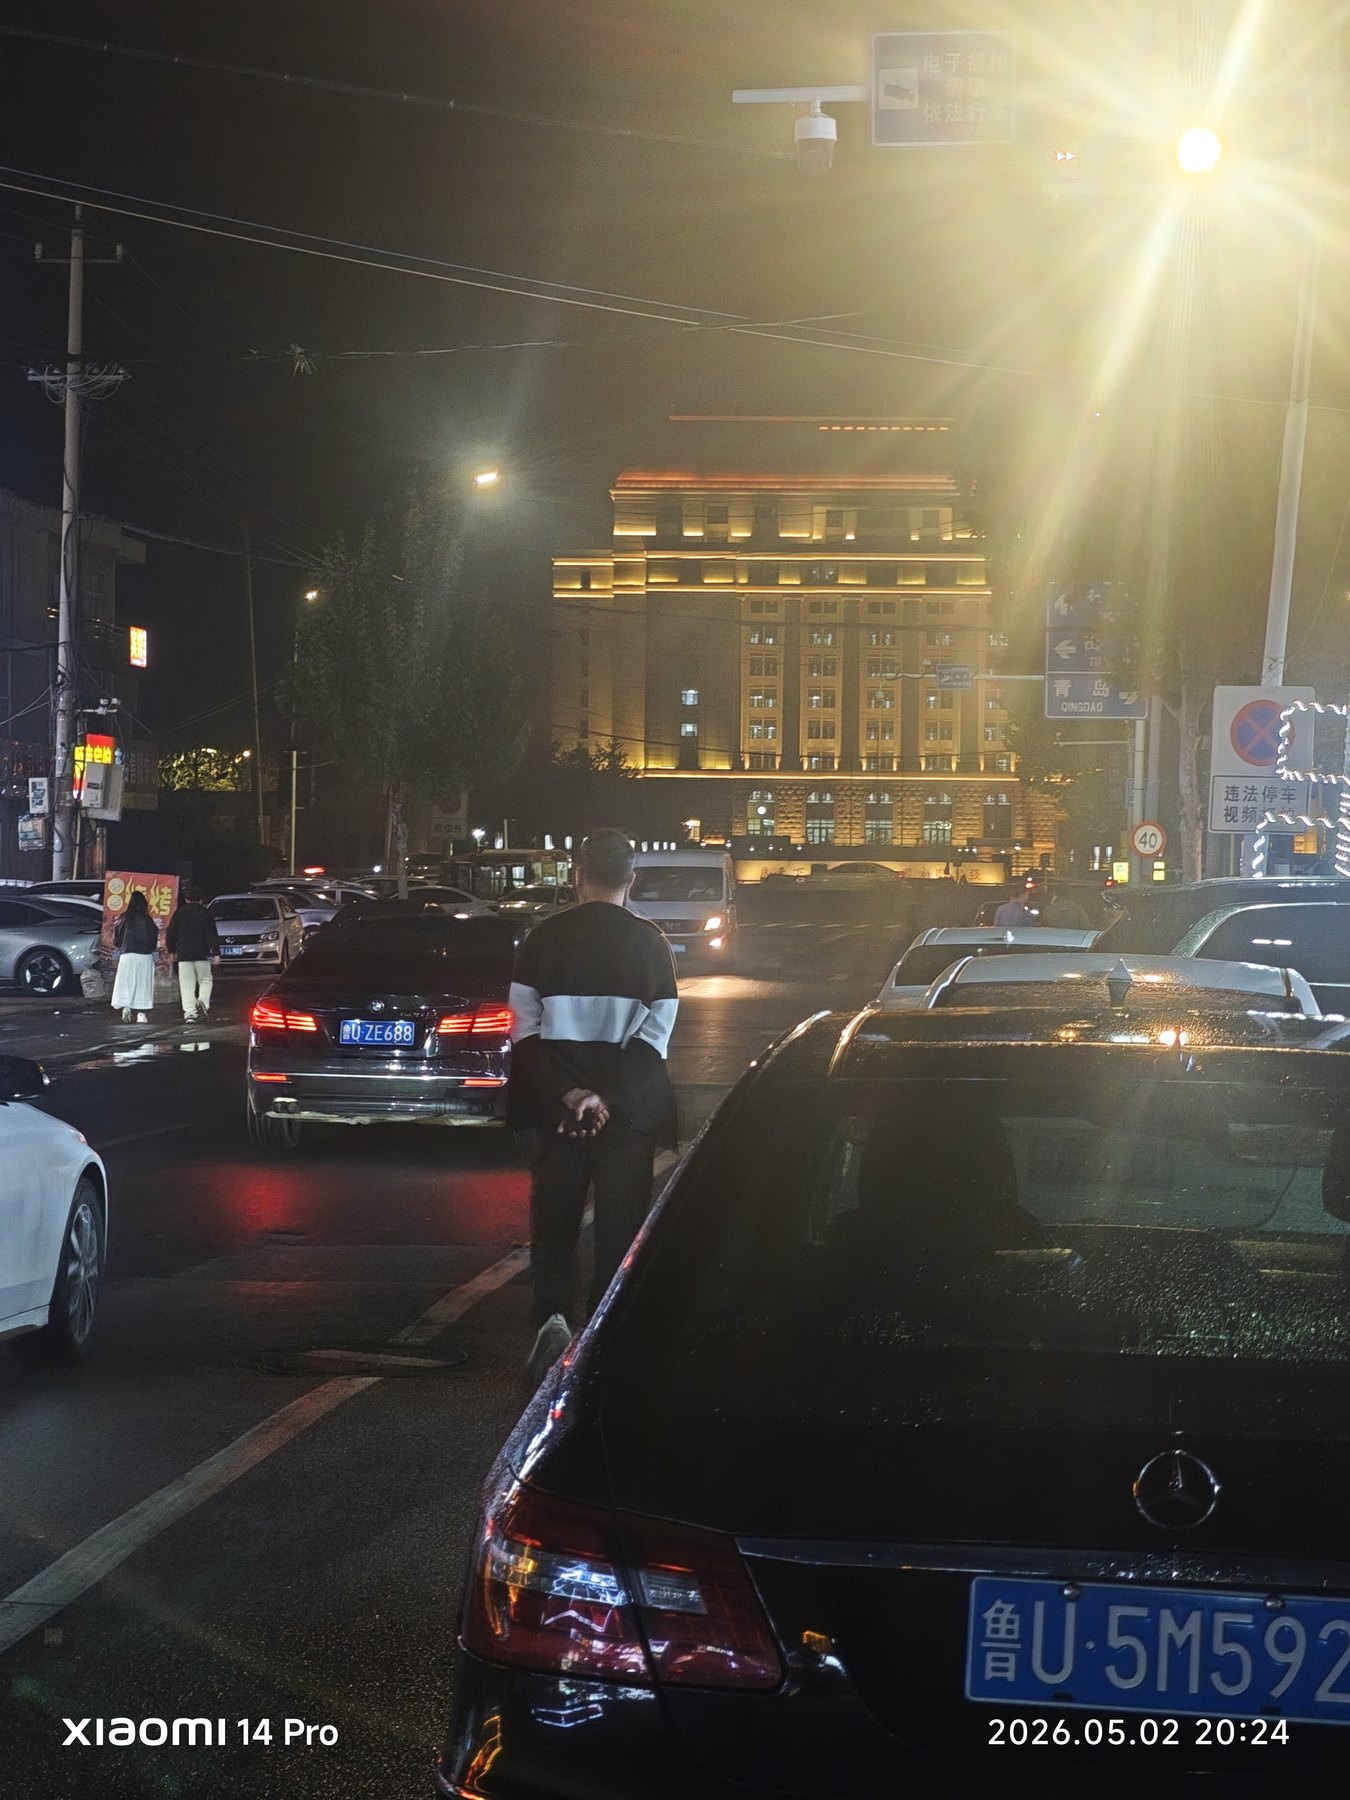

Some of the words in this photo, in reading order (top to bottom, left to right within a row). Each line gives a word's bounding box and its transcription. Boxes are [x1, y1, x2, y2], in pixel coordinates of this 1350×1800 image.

[1053, 678, 1110, 698] 青岛
[1061, 701, 1104, 713] QINGDAO
[1223, 784, 1297, 804] 违法停车
[1138, 831, 1158, 849] 40
